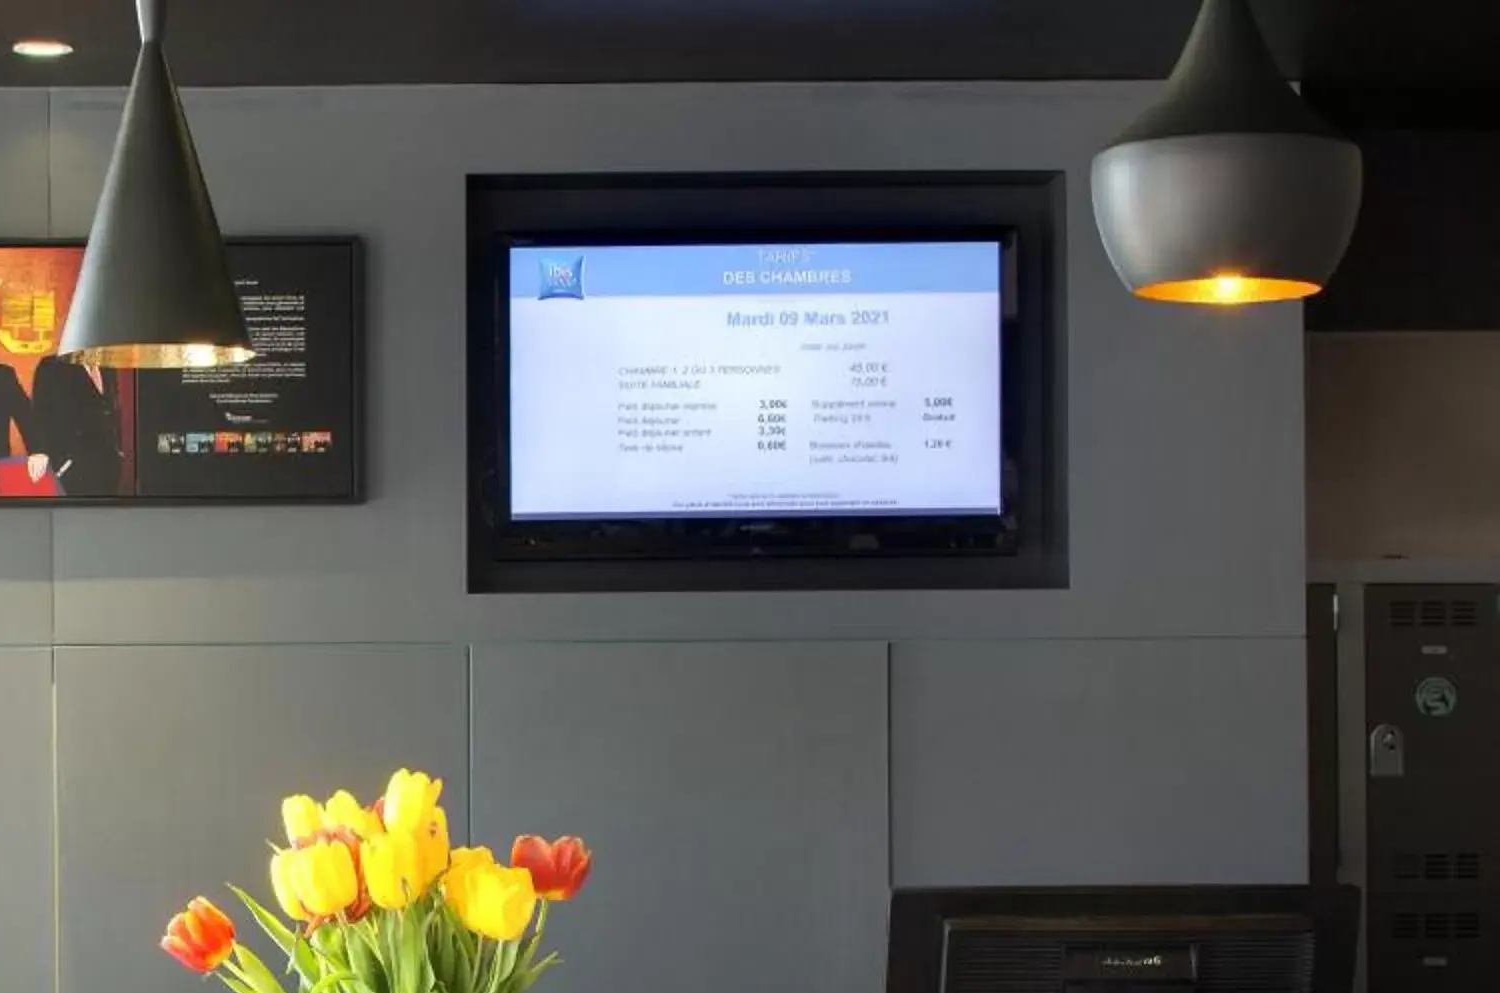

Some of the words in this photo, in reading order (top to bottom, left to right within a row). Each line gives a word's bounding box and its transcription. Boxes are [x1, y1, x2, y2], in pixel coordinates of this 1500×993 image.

[723, 271, 756, 285] DES
[760, 269, 852, 285] CHAMBRES
[727, 311, 774, 327] Mardi
[779, 311, 799, 326] 09
[804, 311, 846, 326] Mars
[851, 310, 890, 326] 2021
